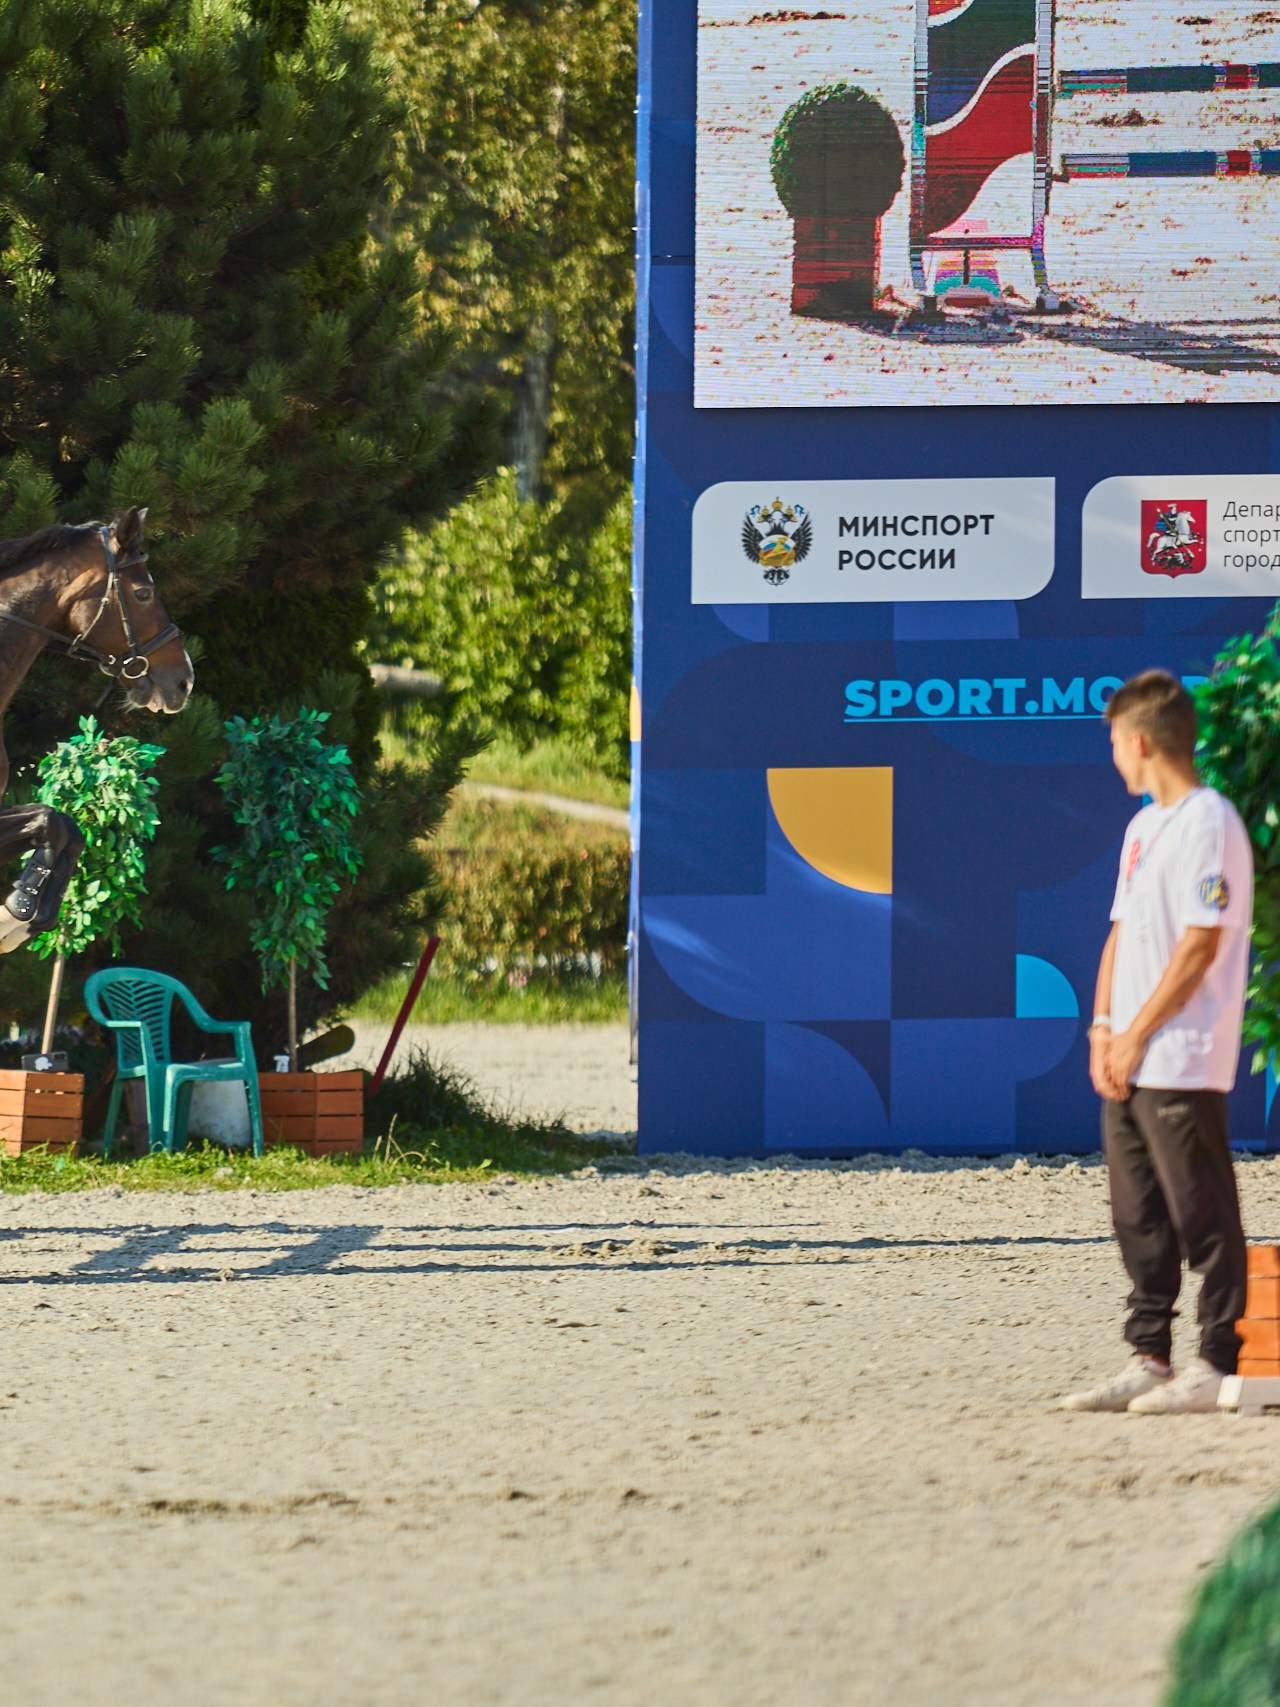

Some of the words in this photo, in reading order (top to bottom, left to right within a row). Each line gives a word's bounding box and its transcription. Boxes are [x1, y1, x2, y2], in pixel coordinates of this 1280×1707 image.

[838, 514, 995, 537] МИНСПОРТ
[1224, 529, 1280, 547] спорт
[838, 549, 955, 570] РОССИИ
[844, 675, 1210, 717] SPORT.MO
